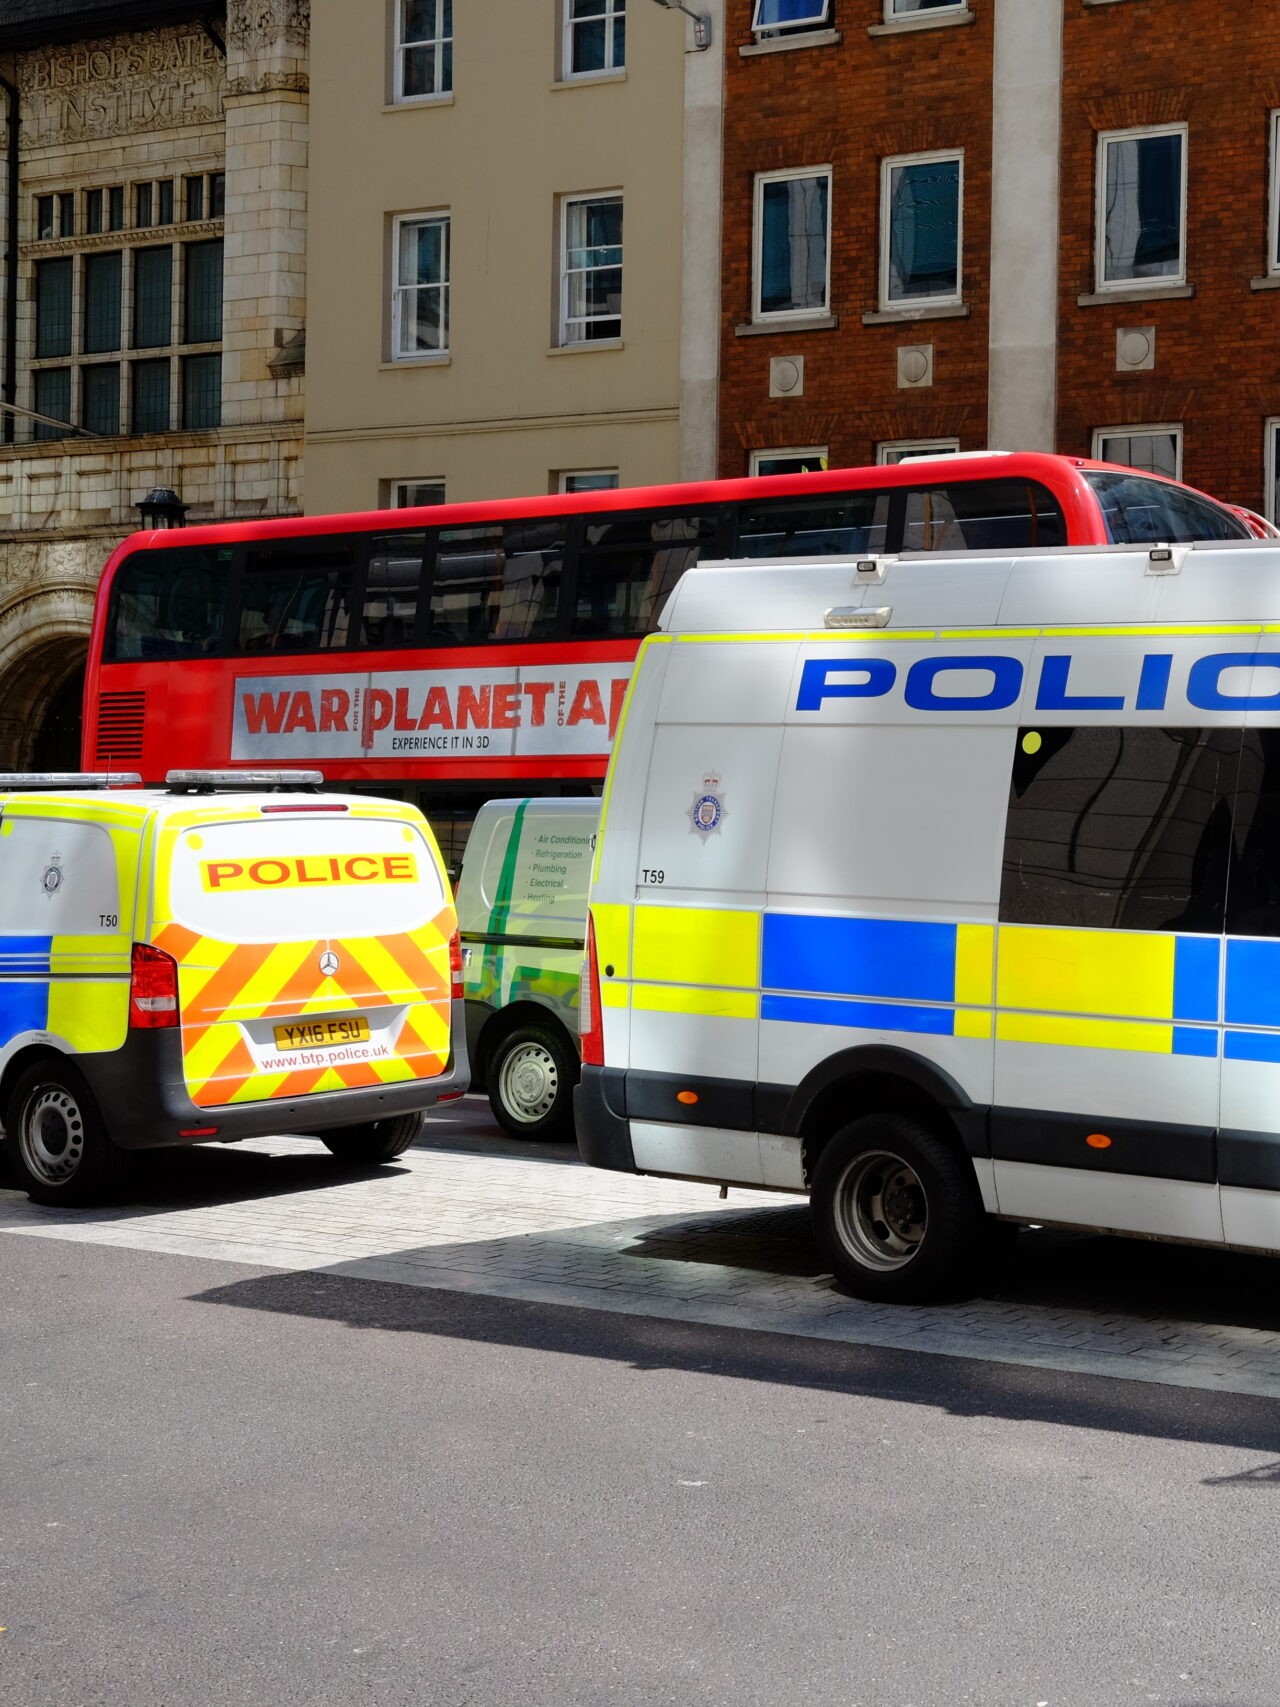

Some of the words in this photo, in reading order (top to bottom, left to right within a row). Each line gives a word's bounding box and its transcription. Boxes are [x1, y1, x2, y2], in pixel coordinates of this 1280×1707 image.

[33, 34, 215, 92] BISHOPSGATE
[558, 680, 567, 709] THE
[242, 688, 350, 735] WAR
[361, 681, 555, 750] PLANET
[557, 709, 566, 727] OF
[392, 736, 448, 750] EXPERIENCE
[451, 736, 459, 749] IT
[462, 736, 474, 749] IN
[476, 735, 490, 749] 3D
[538, 834, 550, 844] Air
[535, 849, 583, 860] Refrigeration
[206, 856, 414, 888] POLICE
[532, 863, 567, 875] Plumbing
[642, 869, 665, 884] T59
[530, 878, 564, 888] Electrical
[527, 893, 555, 905] Heating
[99, 914, 118, 928] T50
[284, 1024, 325, 1046] YX16
[327, 1020, 361, 1041] FSU
[261, 1044, 389, 1069] www.btp.police.uk
